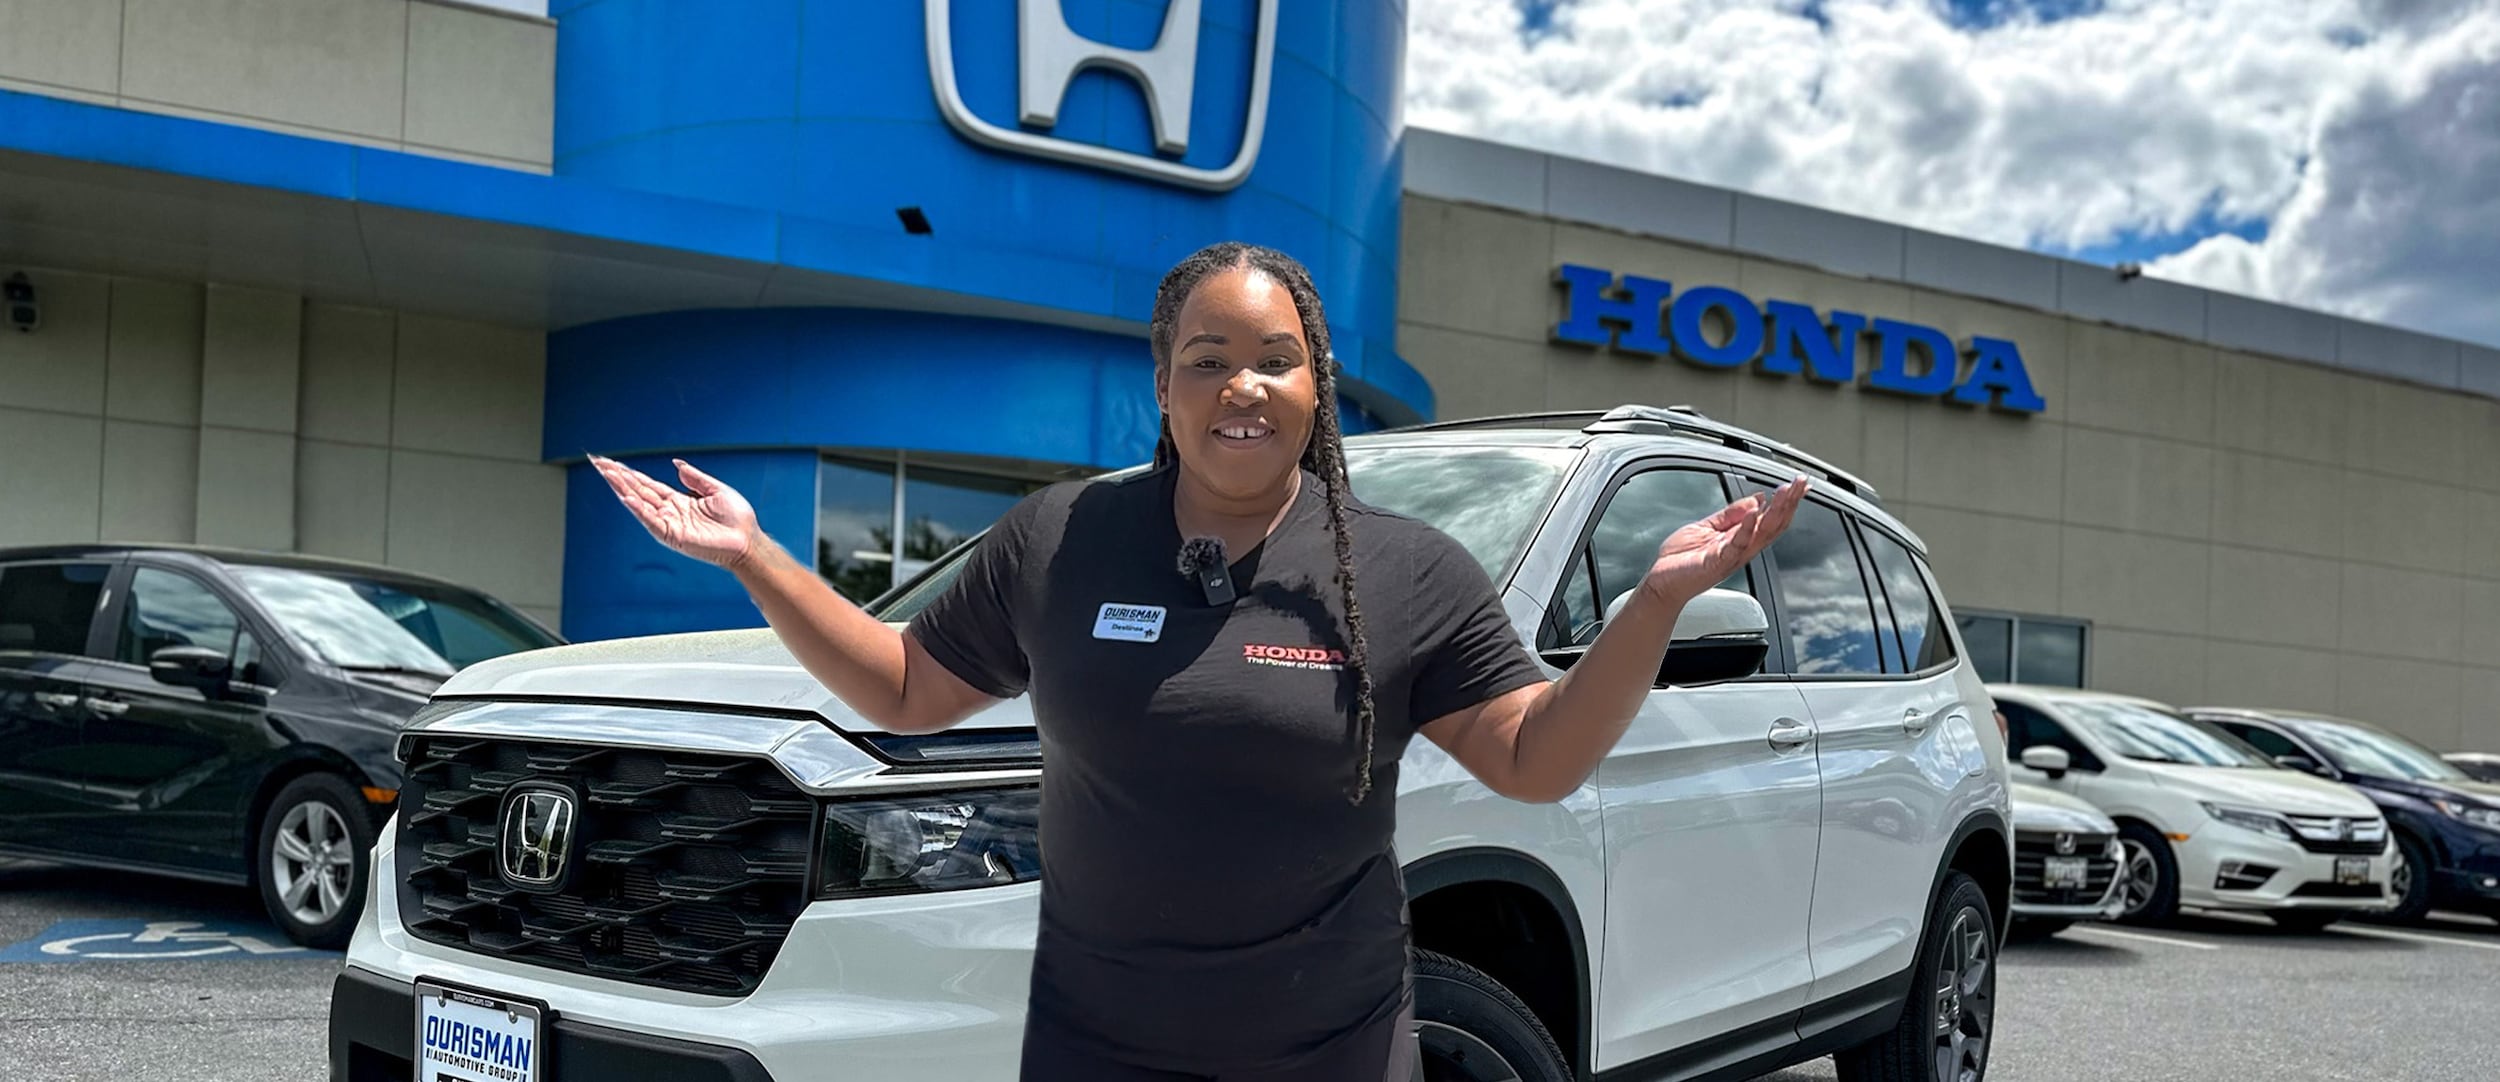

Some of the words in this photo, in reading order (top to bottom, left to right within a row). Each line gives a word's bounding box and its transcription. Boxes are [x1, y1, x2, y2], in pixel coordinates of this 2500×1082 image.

[1553, 263, 2046, 412] HONDA
[1104, 607, 1160, 620] OURISMAN
[1243, 644, 1345, 662] HONDA
[1266, 658, 1295, 667] Power
[1297, 661, 1308, 669] of
[426, 1015, 532, 1071] OURISMAN
[433, 1050, 485, 1074] AUTOMOTIVE
[488, 1065, 518, 1082] GROUP
